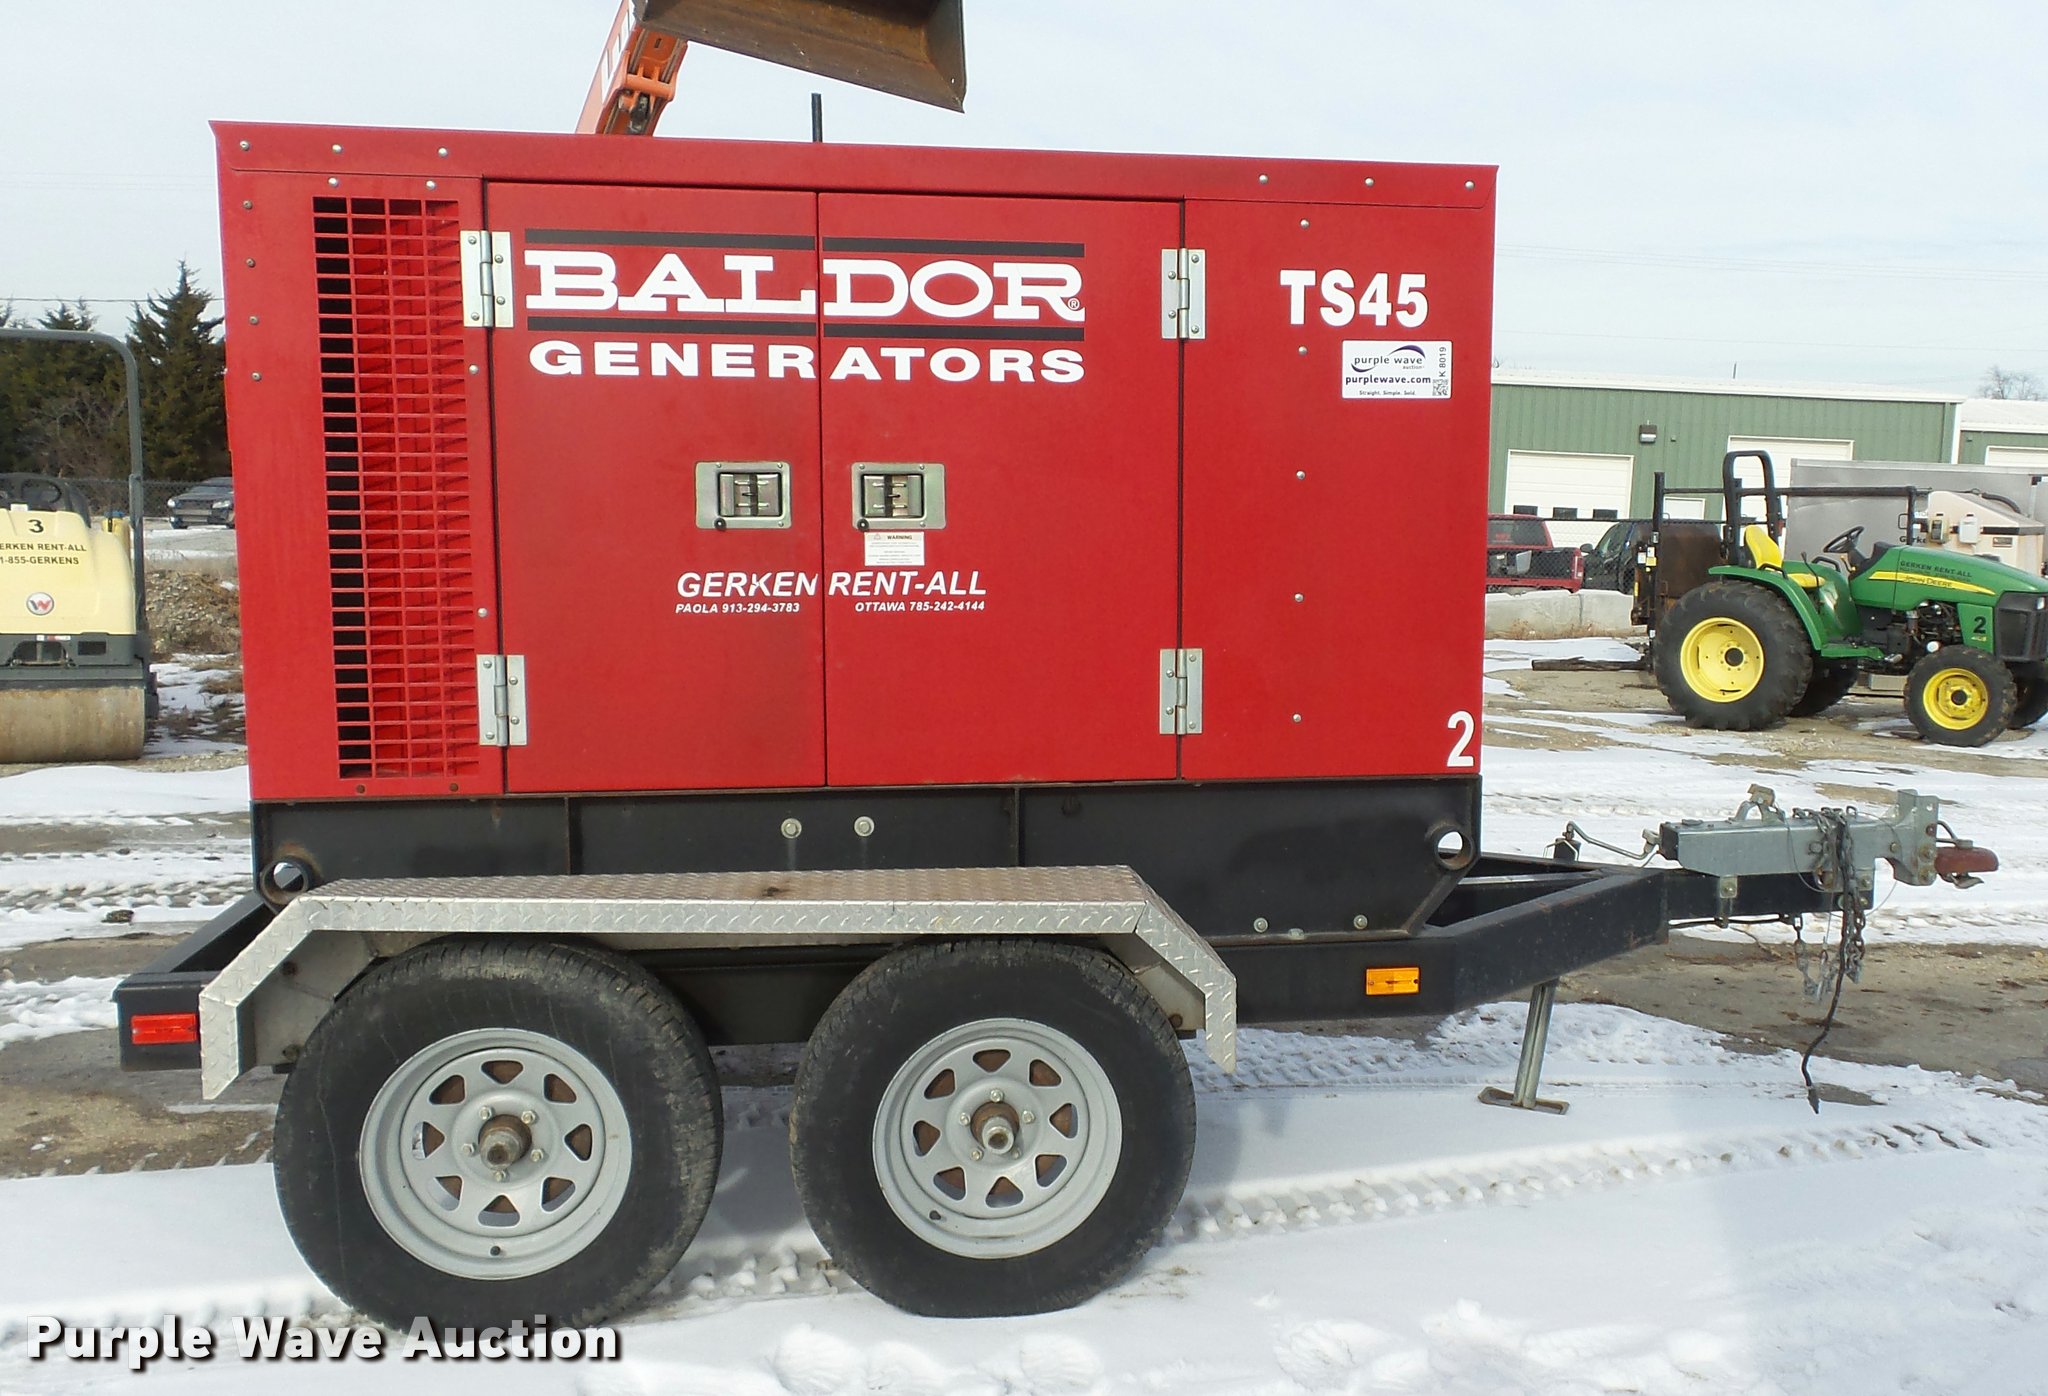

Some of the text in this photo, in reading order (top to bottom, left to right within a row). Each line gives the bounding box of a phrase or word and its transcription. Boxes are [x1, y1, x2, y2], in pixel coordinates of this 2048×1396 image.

[1279, 269, 1429, 328] TS45
[529, 340, 1085, 383] GENERATORS
[1354, 355, 1423, 366] purple wave
[1345, 374, 1431, 386] purplewave.com
[28, 519, 44, 533] 3
[37, 543, 87, 552] RENT-ALL
[0, 556, 79, 565] 1-855-GERKENS
[1900, 560, 1932, 570] GERKEN
[677, 571, 987, 598] GERKEN RENT-ALL
[676, 602, 800, 613] PAOLA 913-294-3783
[855, 601, 985, 612] OTTAWA 785-242-4144
[1973, 616, 1987, 634] 2
[1447, 710, 1475, 767] 2
